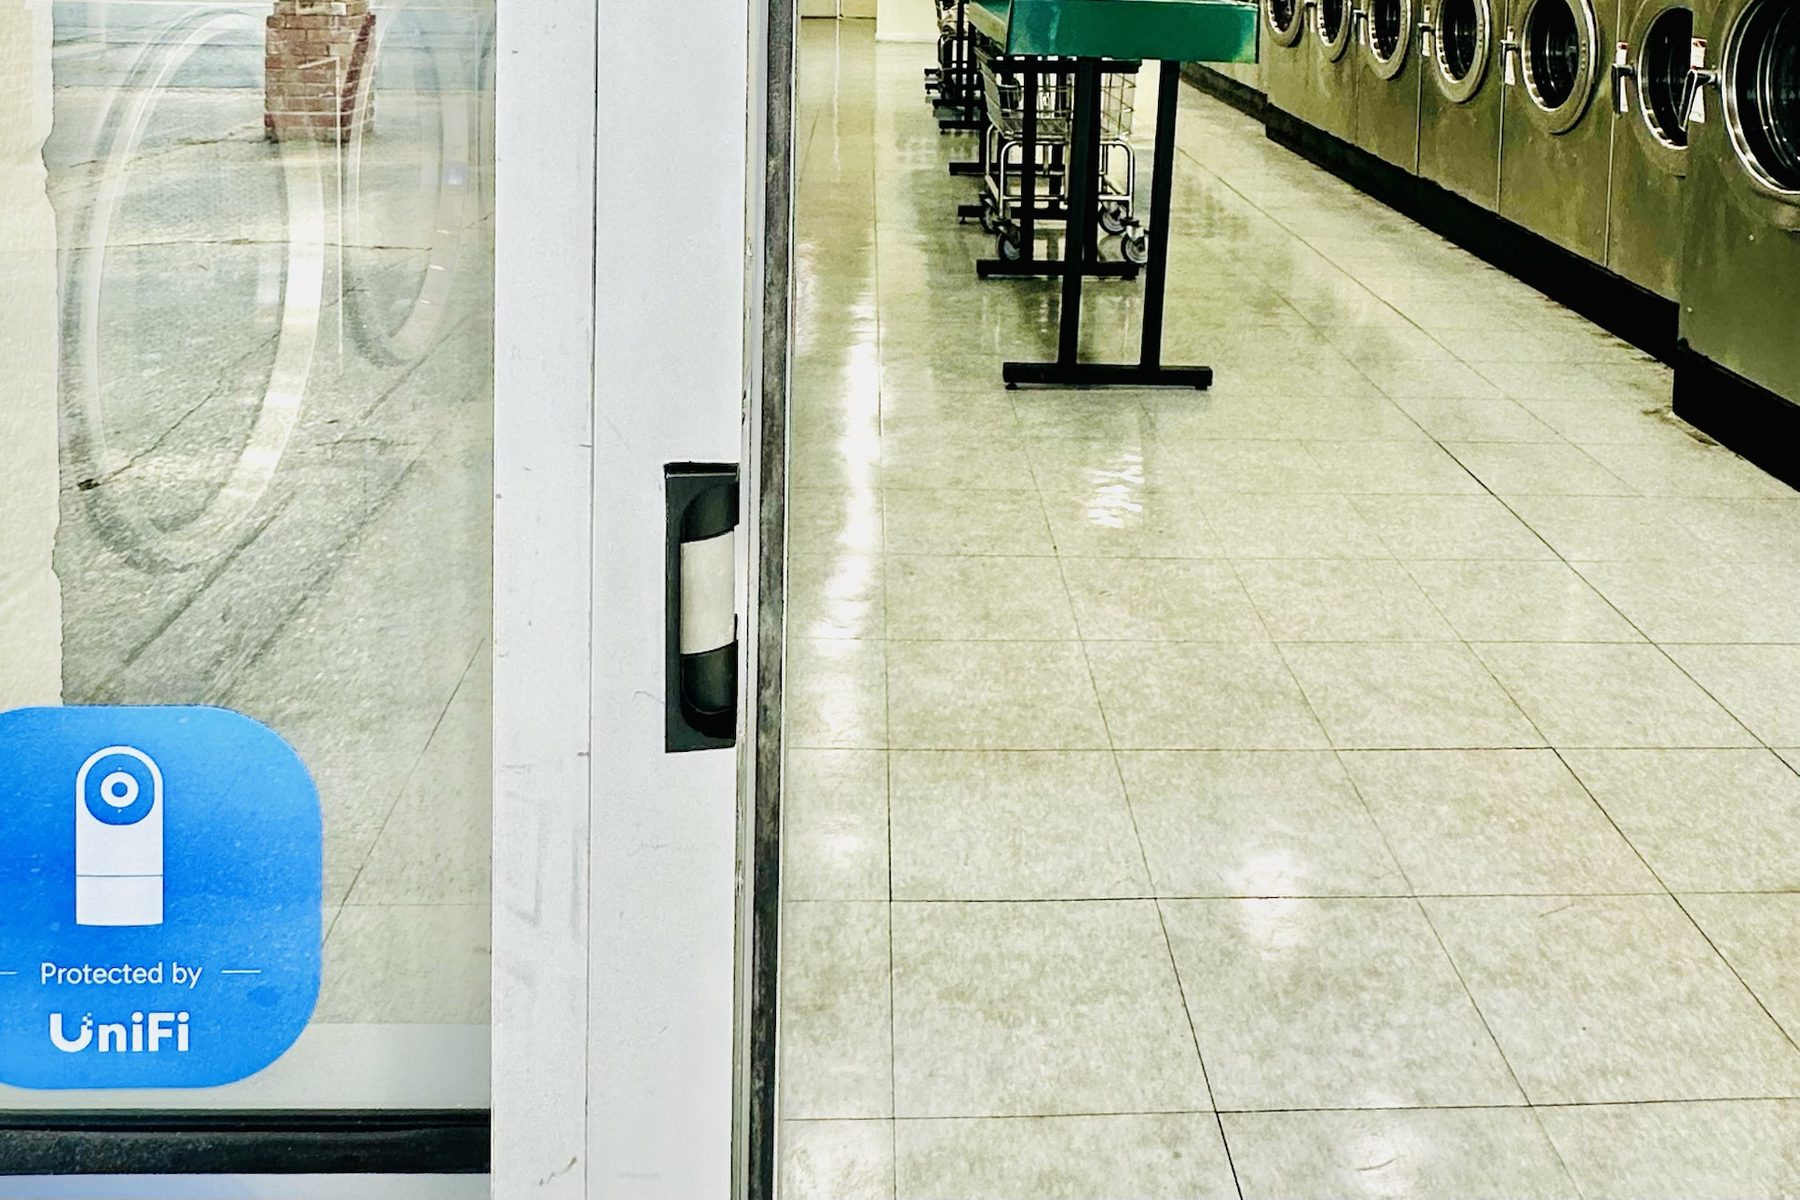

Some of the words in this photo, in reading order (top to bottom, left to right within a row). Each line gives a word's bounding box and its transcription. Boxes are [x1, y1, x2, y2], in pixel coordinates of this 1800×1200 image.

[41, 961, 163, 985] Protected
[172, 961, 203, 989] by
[50, 1011, 190, 1053] UniFi
